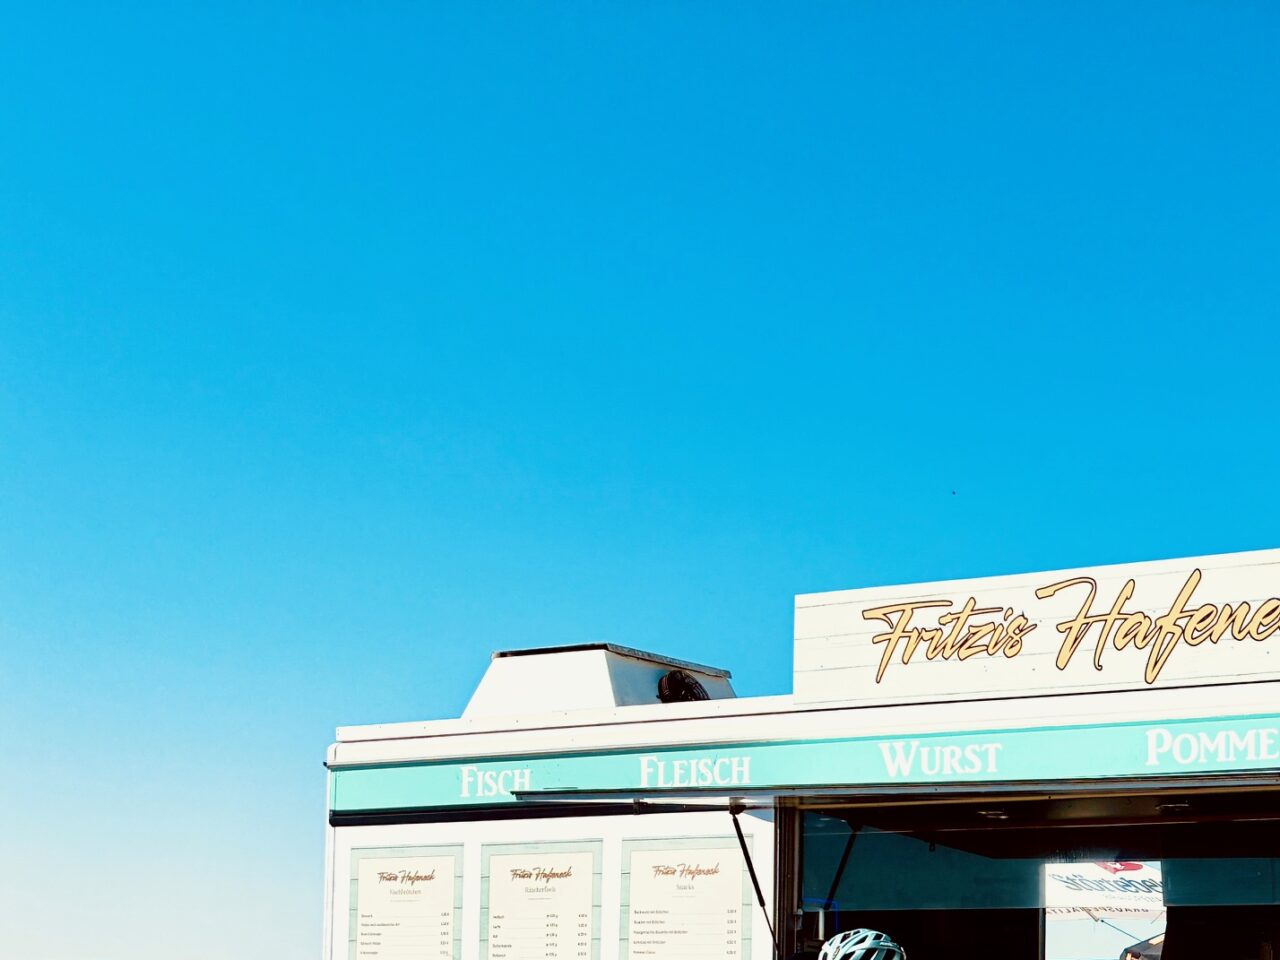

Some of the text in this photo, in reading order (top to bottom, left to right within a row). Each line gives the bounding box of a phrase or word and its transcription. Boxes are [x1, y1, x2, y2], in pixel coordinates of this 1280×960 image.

[862, 597, 1038, 685] Fritzis
[639, 756, 752, 787] FLEISCH
[879, 741, 1003, 780] WURST
[460, 766, 532, 798] FISCH
